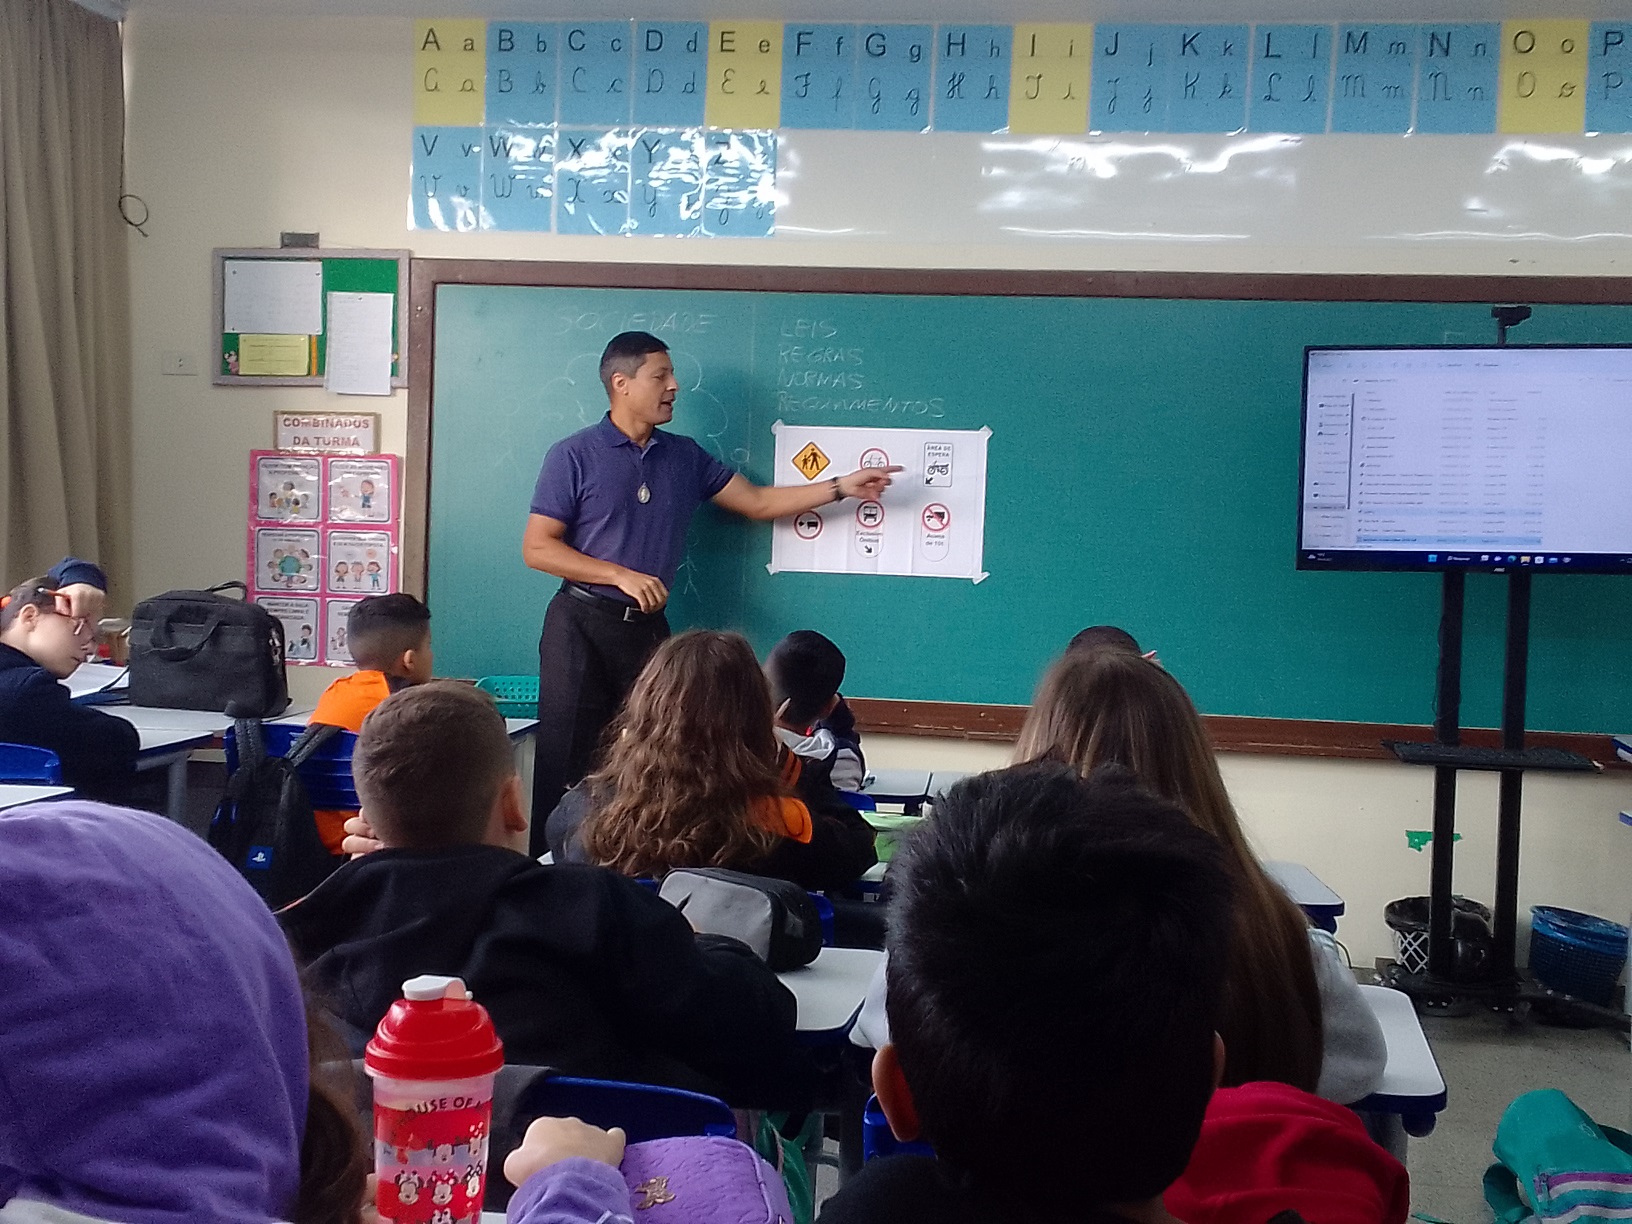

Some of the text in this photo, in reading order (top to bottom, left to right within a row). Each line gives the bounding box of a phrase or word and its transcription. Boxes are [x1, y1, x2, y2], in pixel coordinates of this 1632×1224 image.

[422, 28, 474, 51] A a
[499, 29, 547, 52] B b
[568, 29, 621, 52] C c
[646, 30, 697, 52] D d
[721, 31, 770, 53] E e
[797, 32, 813, 56] F
[866, 33, 921, 63] G g
[947, 33, 1000, 57] H h
[1105, 32, 1118, 56] J
[1182, 32, 1232, 56] K k
[1265, 33, 1281, 58] L
[1345, 31, 1406, 54] M m
[1429, 32, 1486, 57] N n
[1514, 31, 1574, 54] O o
[1603, 31, 1624, 56] P
[421, 135, 471, 156] V v
[489, 136, 513, 157] W
[568, 139, 586, 157] X
[642, 140, 660, 163] Y
[779, 317, 838, 339] LEIS
[777, 342, 865, 366] REGRAS
[777, 368, 866, 390] NORMAS
[282, 416, 370, 429] COMBINADOS
[292, 435, 361, 447] DA TURMA
